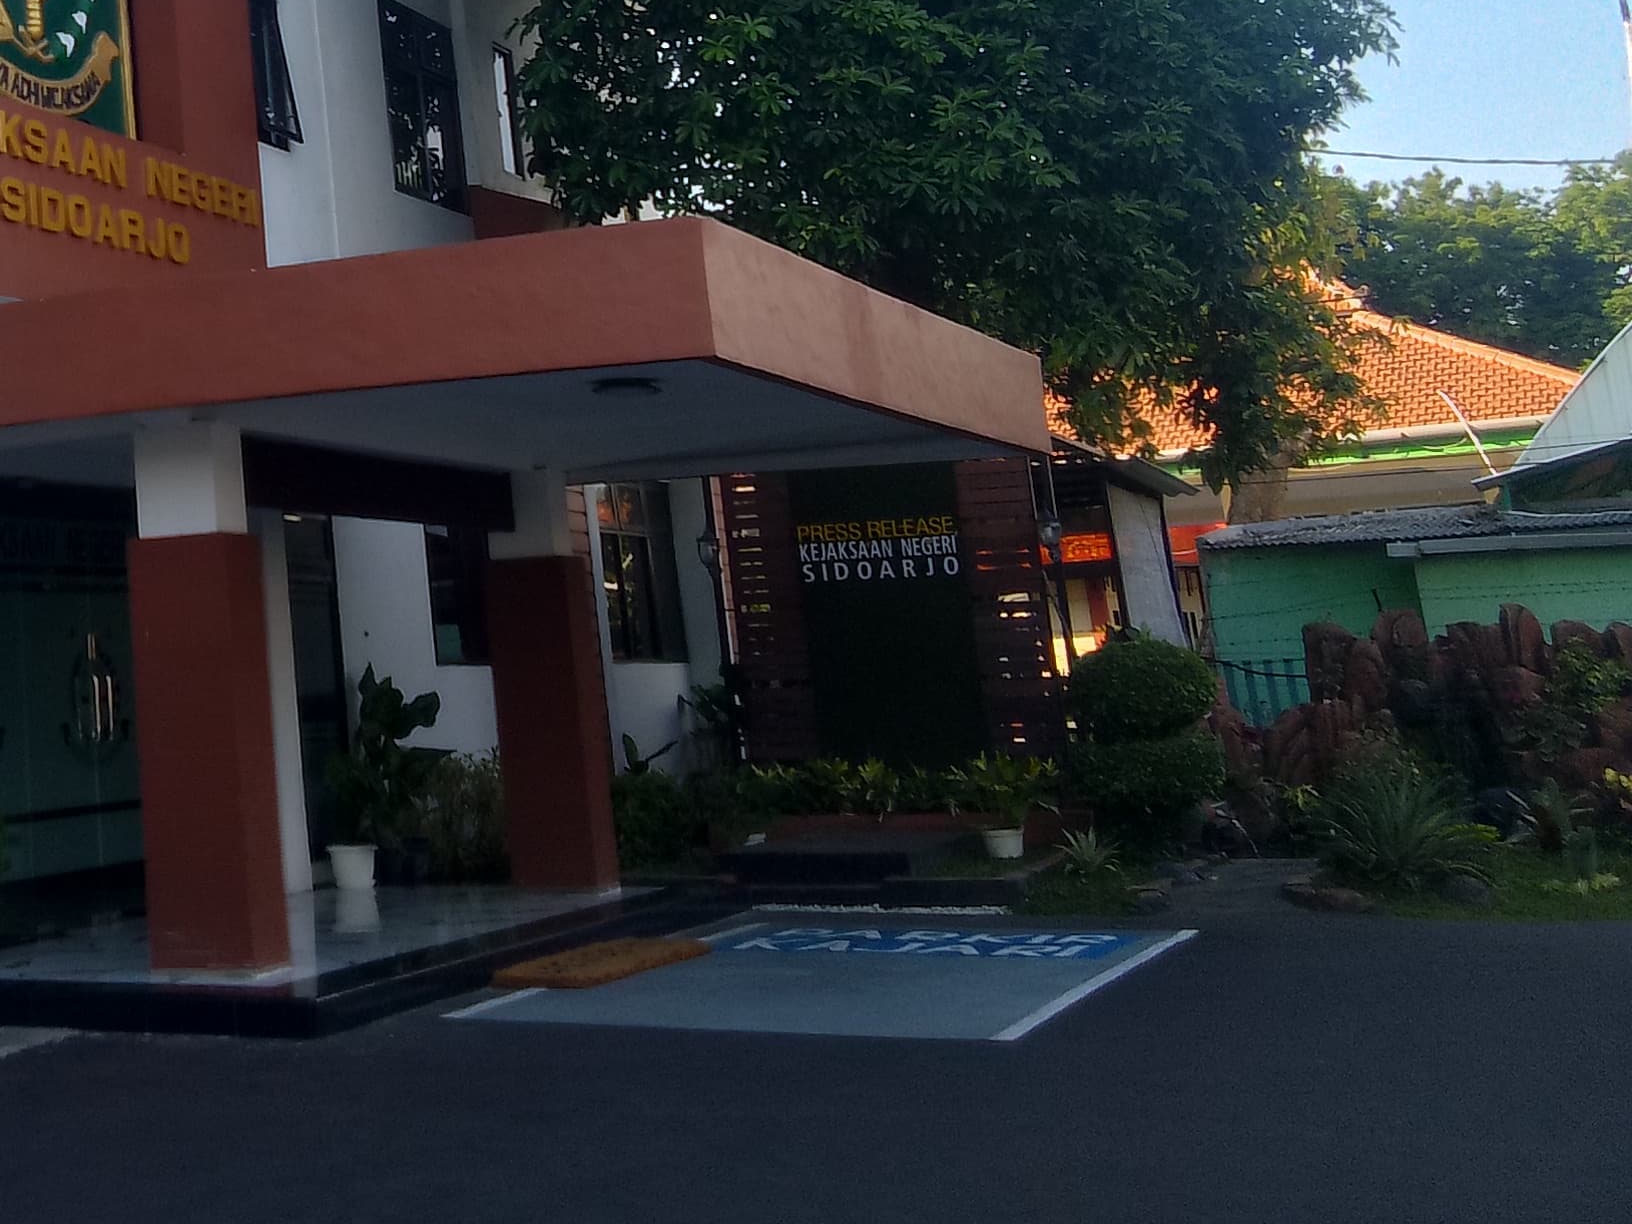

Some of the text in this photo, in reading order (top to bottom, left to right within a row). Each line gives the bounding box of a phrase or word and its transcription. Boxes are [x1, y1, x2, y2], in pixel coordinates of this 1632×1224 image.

[145, 155, 260, 227] NEGERI
[796, 522, 861, 543] PRESS
[799, 534, 957, 562] KEJAKSAAN NEGERI
[732, 937, 1093, 958] KAJARI
